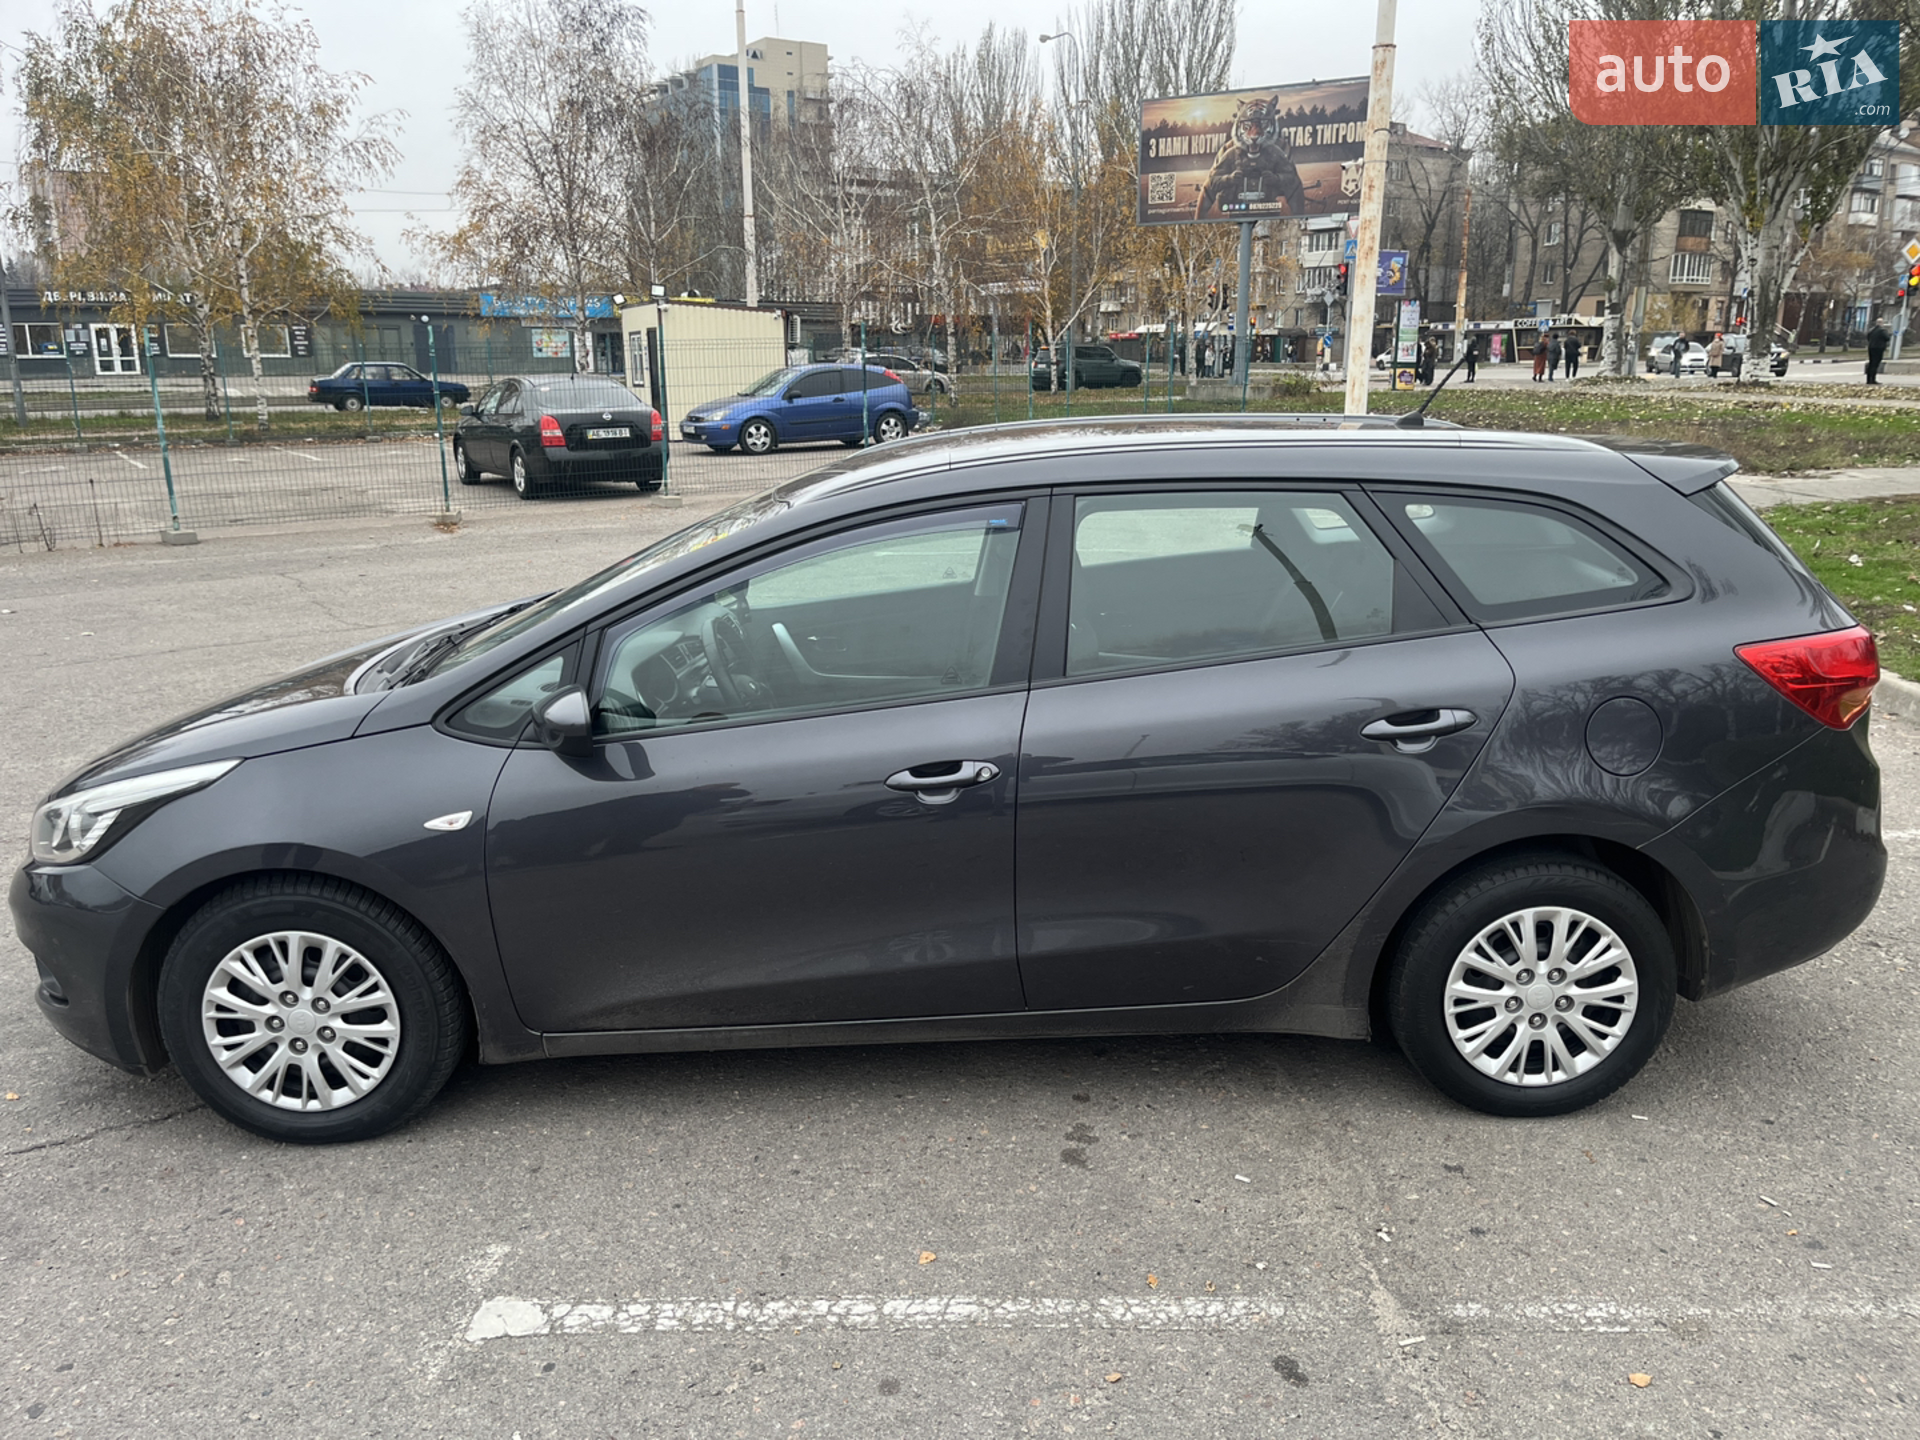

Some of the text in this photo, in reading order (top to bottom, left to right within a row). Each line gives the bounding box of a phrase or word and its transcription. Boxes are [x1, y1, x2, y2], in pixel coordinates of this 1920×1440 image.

[1149, 138, 1156, 158] З
[1158, 135, 1189, 157] НАМИ
[1316, 121, 1367, 145] ТИГРОМ
